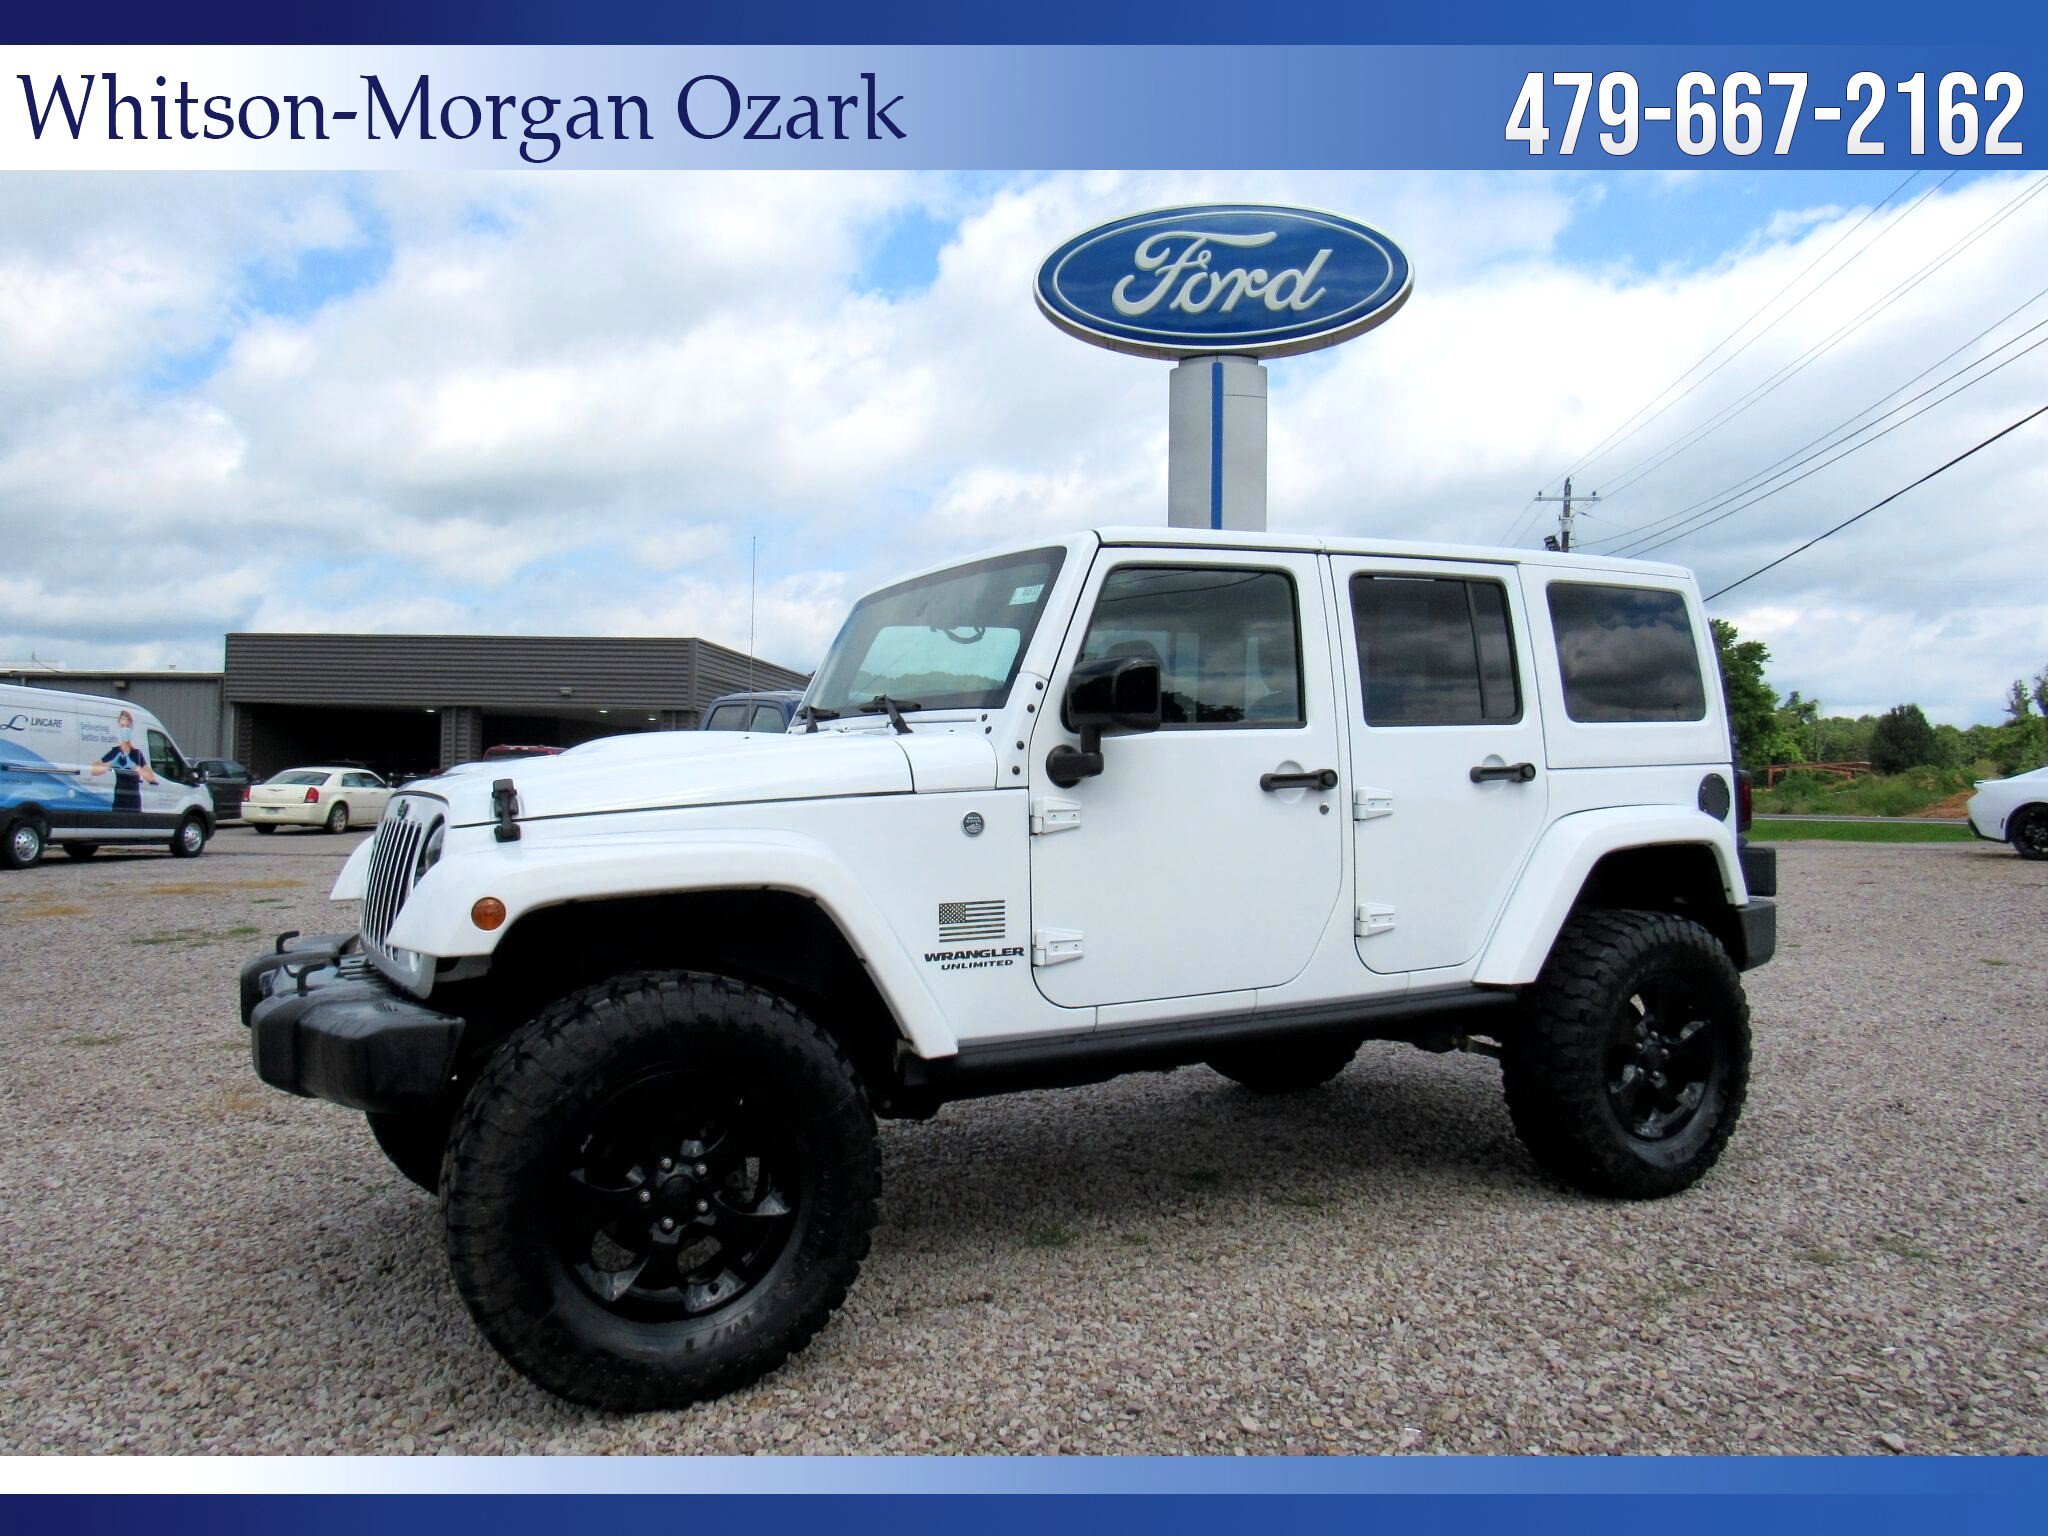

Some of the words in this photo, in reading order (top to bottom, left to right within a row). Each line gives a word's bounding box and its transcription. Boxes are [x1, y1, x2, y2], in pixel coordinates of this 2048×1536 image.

[1111, 230, 1333, 316] Ford
[30, 717, 63, 728] LINCARE
[924, 946, 1025, 962] WRANGLER
[940, 959, 1014, 971] UNLIMITED
